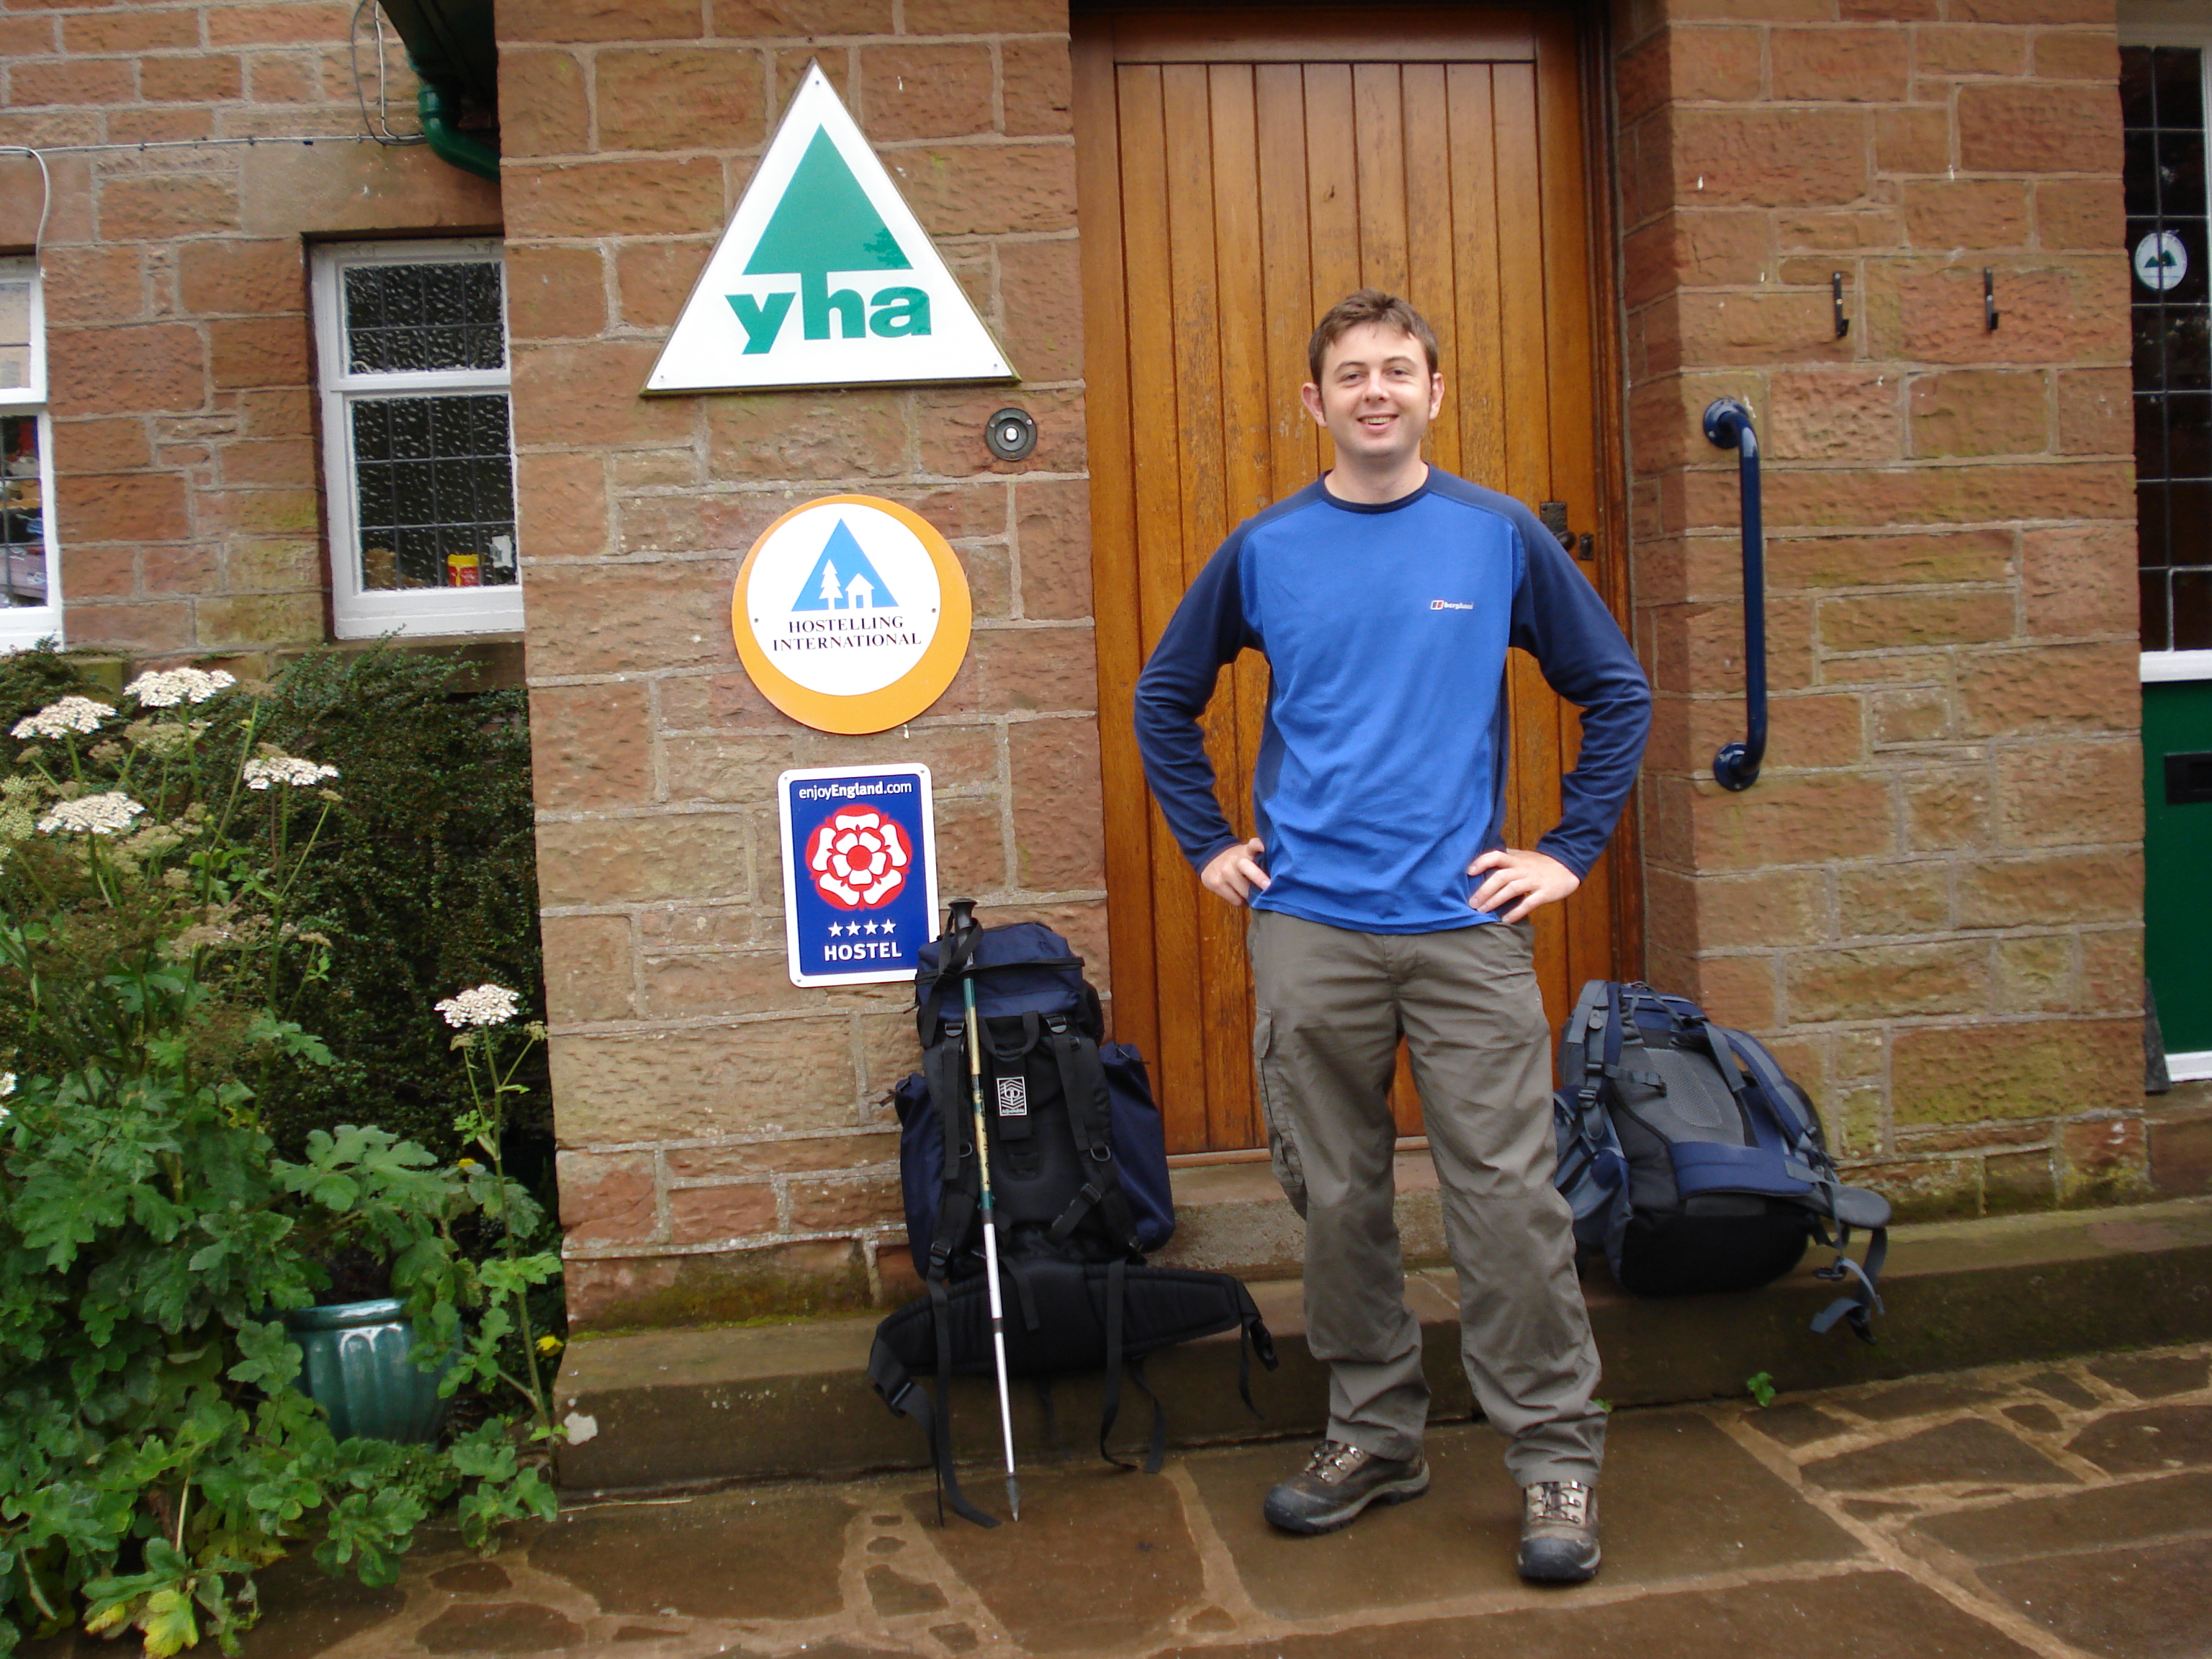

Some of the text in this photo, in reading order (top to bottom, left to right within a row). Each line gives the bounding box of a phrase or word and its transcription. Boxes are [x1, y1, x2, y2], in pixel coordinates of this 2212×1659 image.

[725, 272, 932, 355] yha
[788, 616, 904, 634] HOSTELLING
[773, 632, 922, 652] INTERNATIONAL
[799, 781, 912, 801] enjoyEngland.com
[824, 942, 902, 961] HOSTEL
